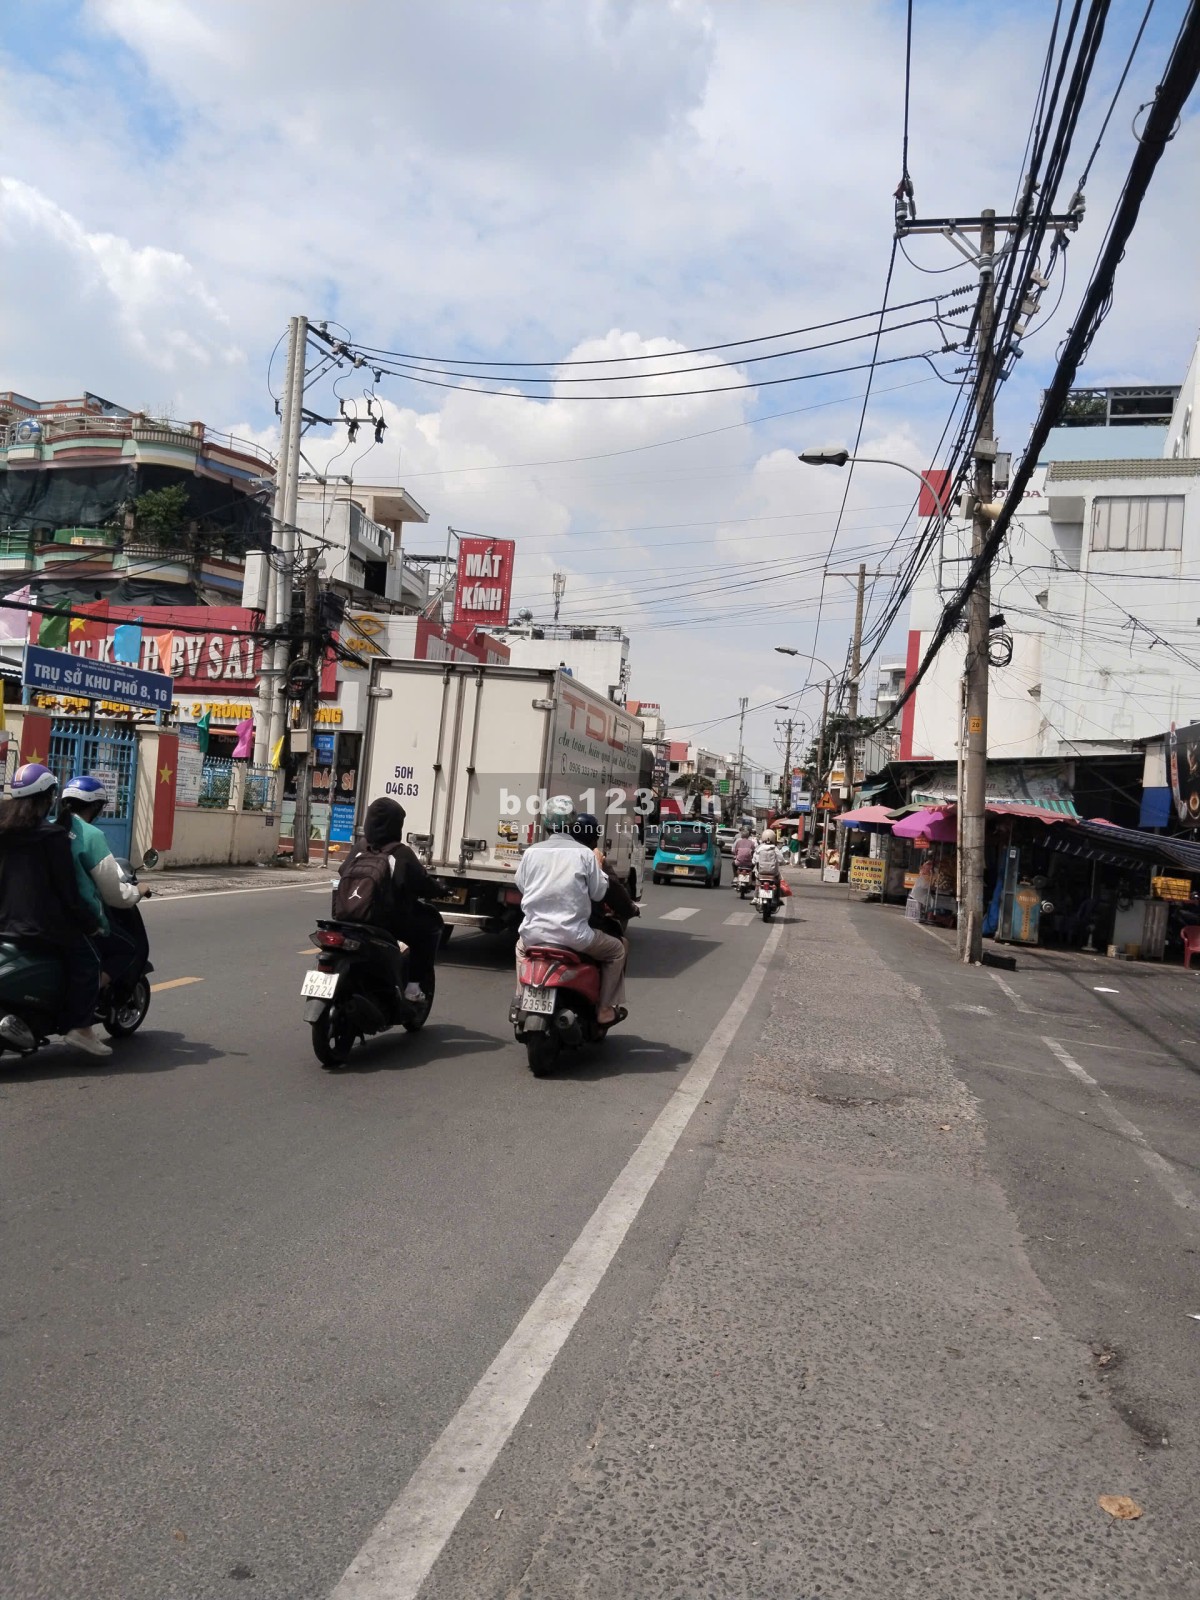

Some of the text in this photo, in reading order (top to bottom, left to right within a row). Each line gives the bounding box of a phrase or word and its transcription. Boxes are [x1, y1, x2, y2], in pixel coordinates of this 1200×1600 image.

[466, 546, 502, 577] MẮT
[461, 582, 502, 610] KÍNH
[34, 664, 60, 684] TRỤ
[64, 668, 82, 685] SỞ
[85, 674, 110, 690] KHU
[114, 680, 138, 696] PHỐ
[155, 689, 167, 702] 16
[191, 702, 202, 718] 2
[562, 692, 624, 751] TDL
[394, 766, 414, 780] 50H
[386, 782, 419, 796] 046.63
[304, 984, 332, 997] 187.24
[523, 998, 552, 1012] 235.56
